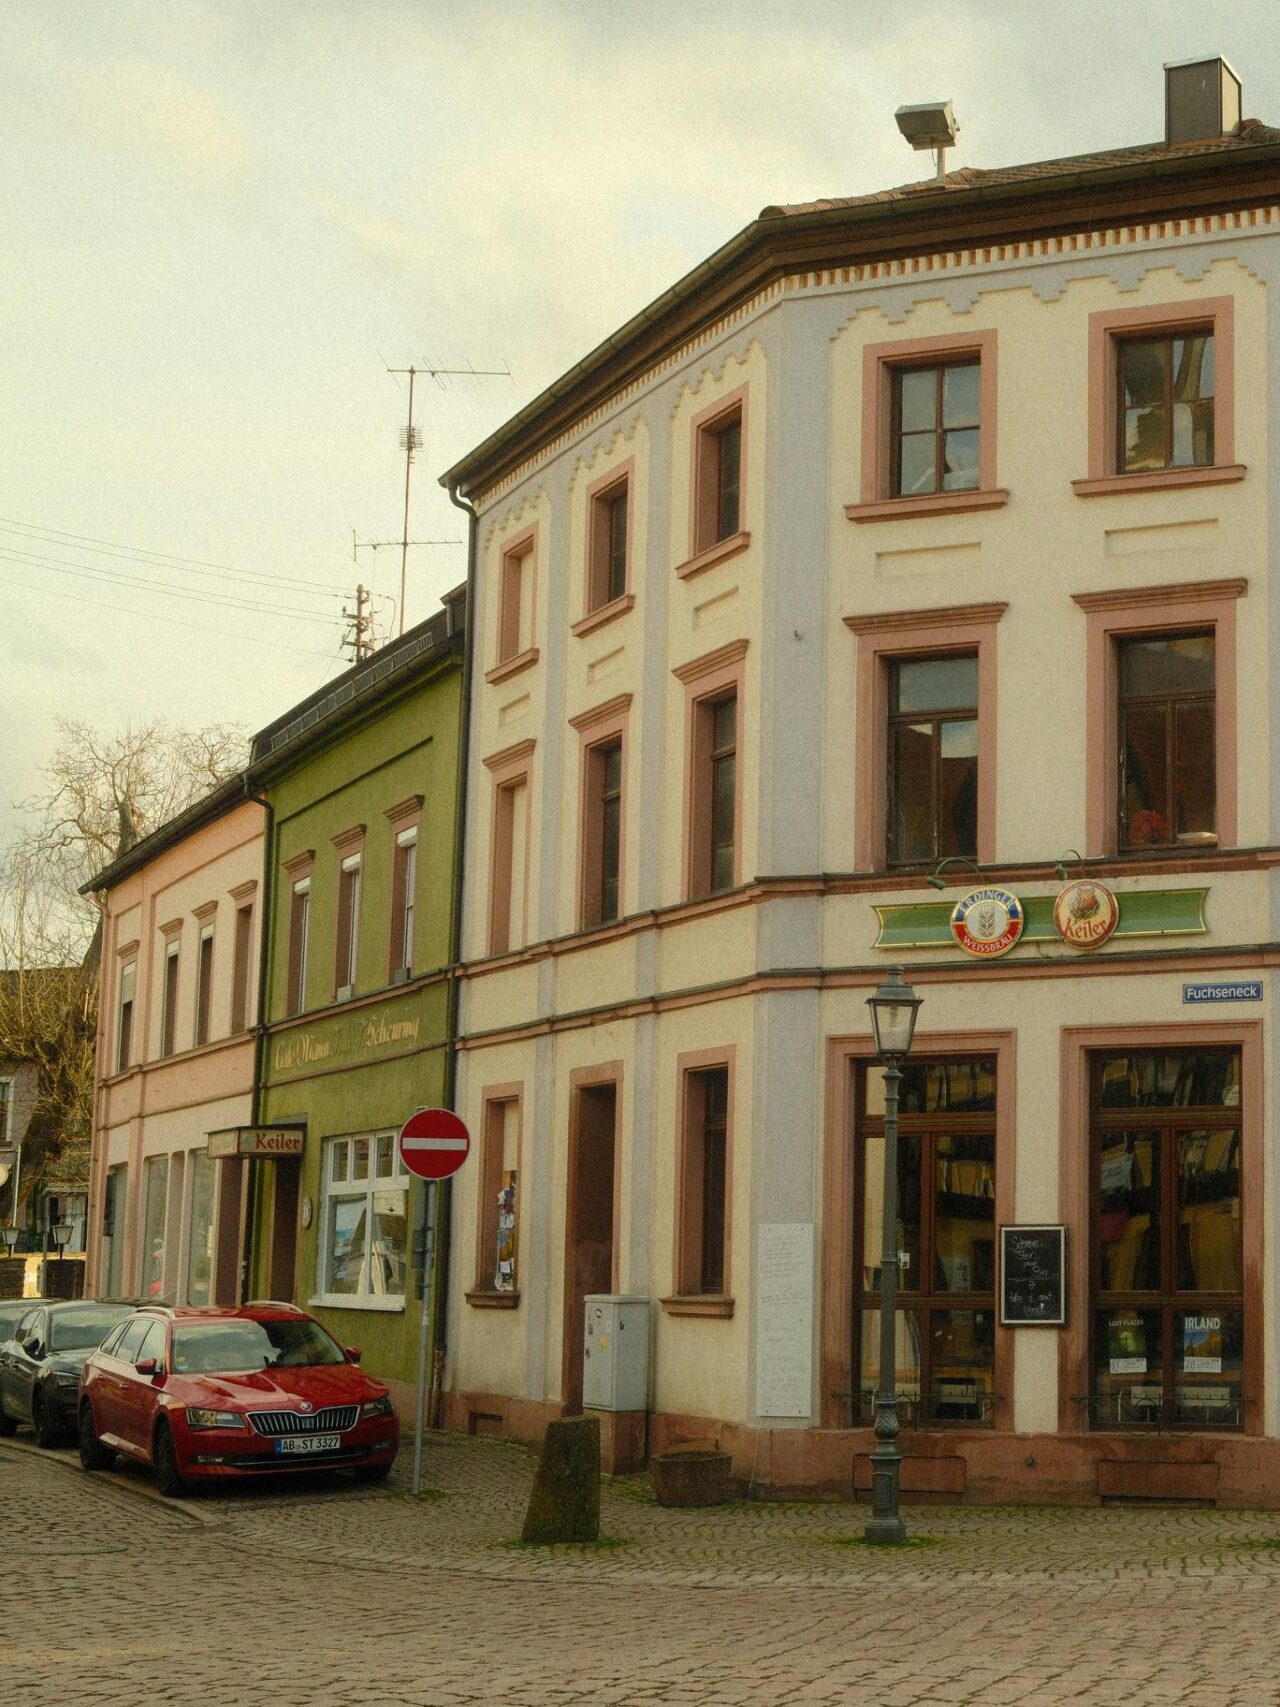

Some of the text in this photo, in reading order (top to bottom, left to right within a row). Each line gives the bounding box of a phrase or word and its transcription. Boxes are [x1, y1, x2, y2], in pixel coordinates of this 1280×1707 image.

[958, 889, 1017, 913] ERDINGER
[1063, 917, 1108, 940] Keiler
[1186, 985, 1258, 999] Fuchseneck
[255, 1132, 301, 1151] Keiler
[1184, 1316, 1221, 1330] IRLAND
[283, 1437, 339, 1450] AB ST 3327
